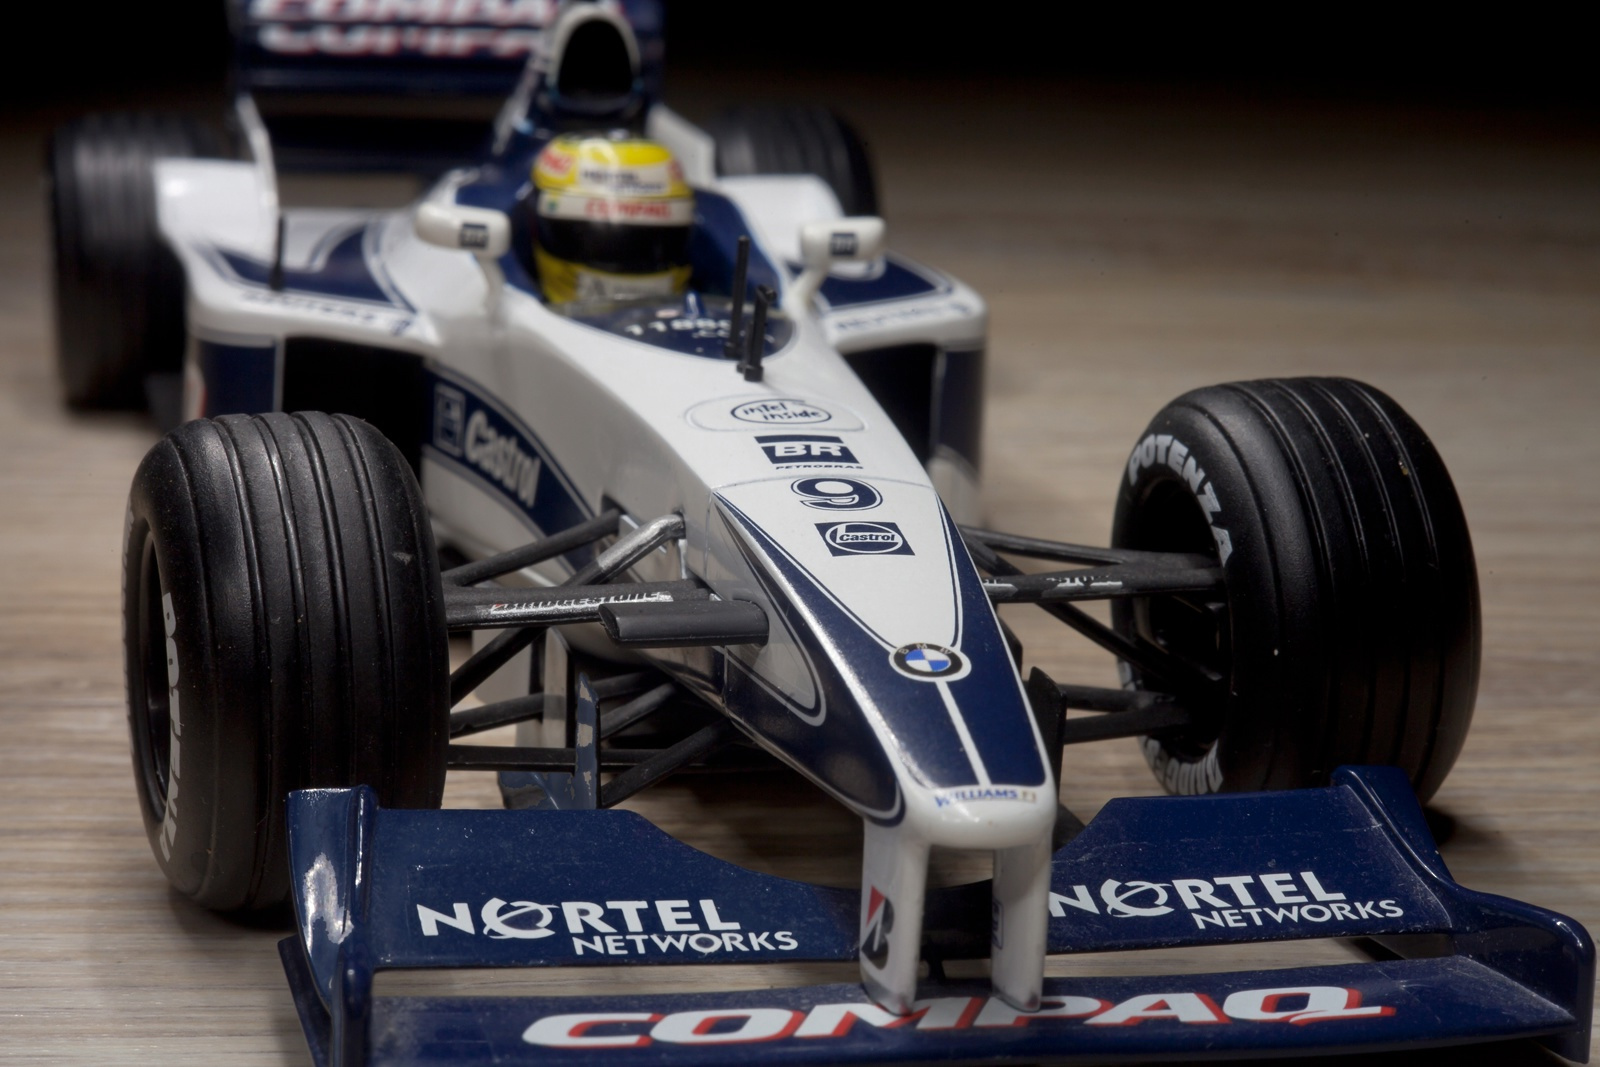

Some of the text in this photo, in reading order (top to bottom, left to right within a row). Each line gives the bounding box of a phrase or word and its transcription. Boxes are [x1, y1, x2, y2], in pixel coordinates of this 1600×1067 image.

[743, 402, 789, 416] intel
[762, 408, 823, 422] inside
[465, 409, 541, 508] Castrol
[773, 442, 843, 458] BR
[790, 477, 883, 512] 9
[1128, 433, 1233, 567] POTENZA
[839, 532, 896, 543] Castrol
[1047, 870, 1347, 919] NORTEL
[416, 897, 741, 941] NORTEL
[1191, 898, 1405, 931] NETWORKS
[572, 930, 799, 957] NETWORKS
[521, 985, 1398, 1050] COMPAQ
